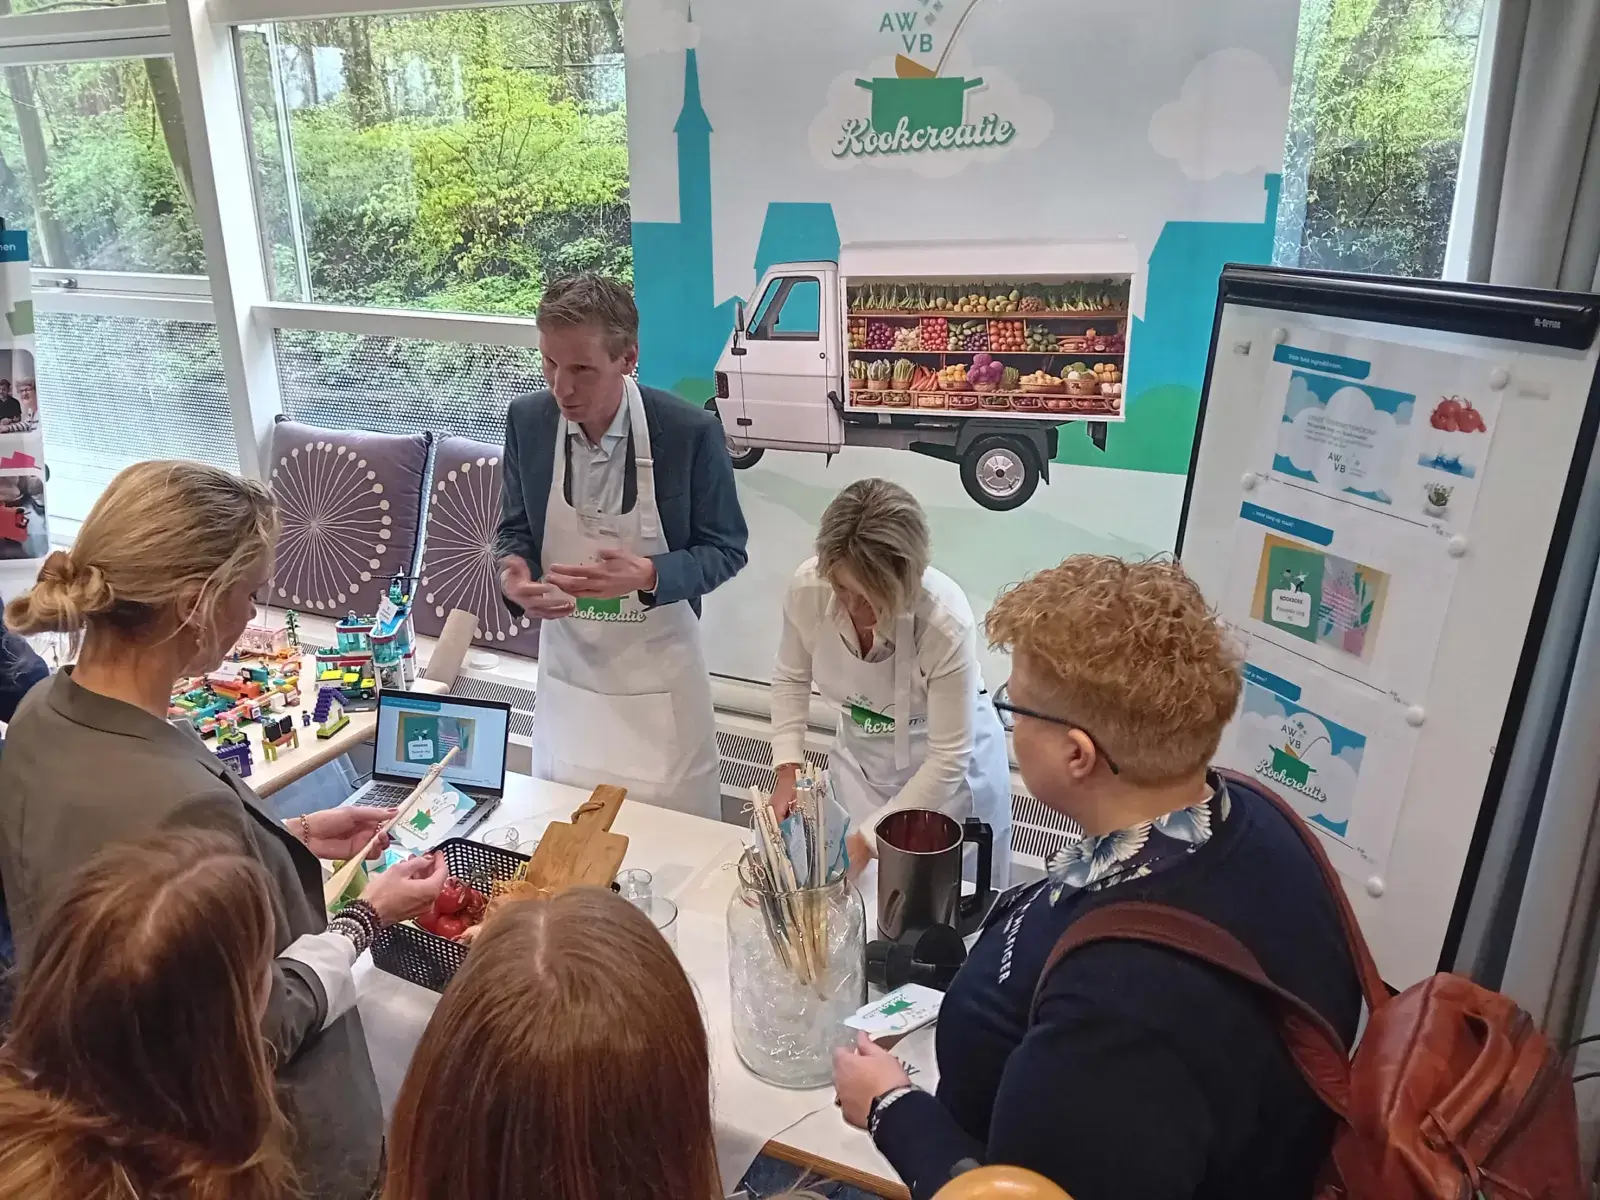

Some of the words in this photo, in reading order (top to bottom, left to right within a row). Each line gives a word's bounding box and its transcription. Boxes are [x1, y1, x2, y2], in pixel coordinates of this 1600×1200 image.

[879, 12, 918, 33] AW
[902, 33, 933, 53] VB
[832, 112, 1016, 157] Kookcreatie
[567, 605, 647, 622] ookcreatie
[1281, 724, 1297, 738] AW
[1288, 737, 1302, 749] VB
[1254, 758, 1327, 802] Kookcreatie
